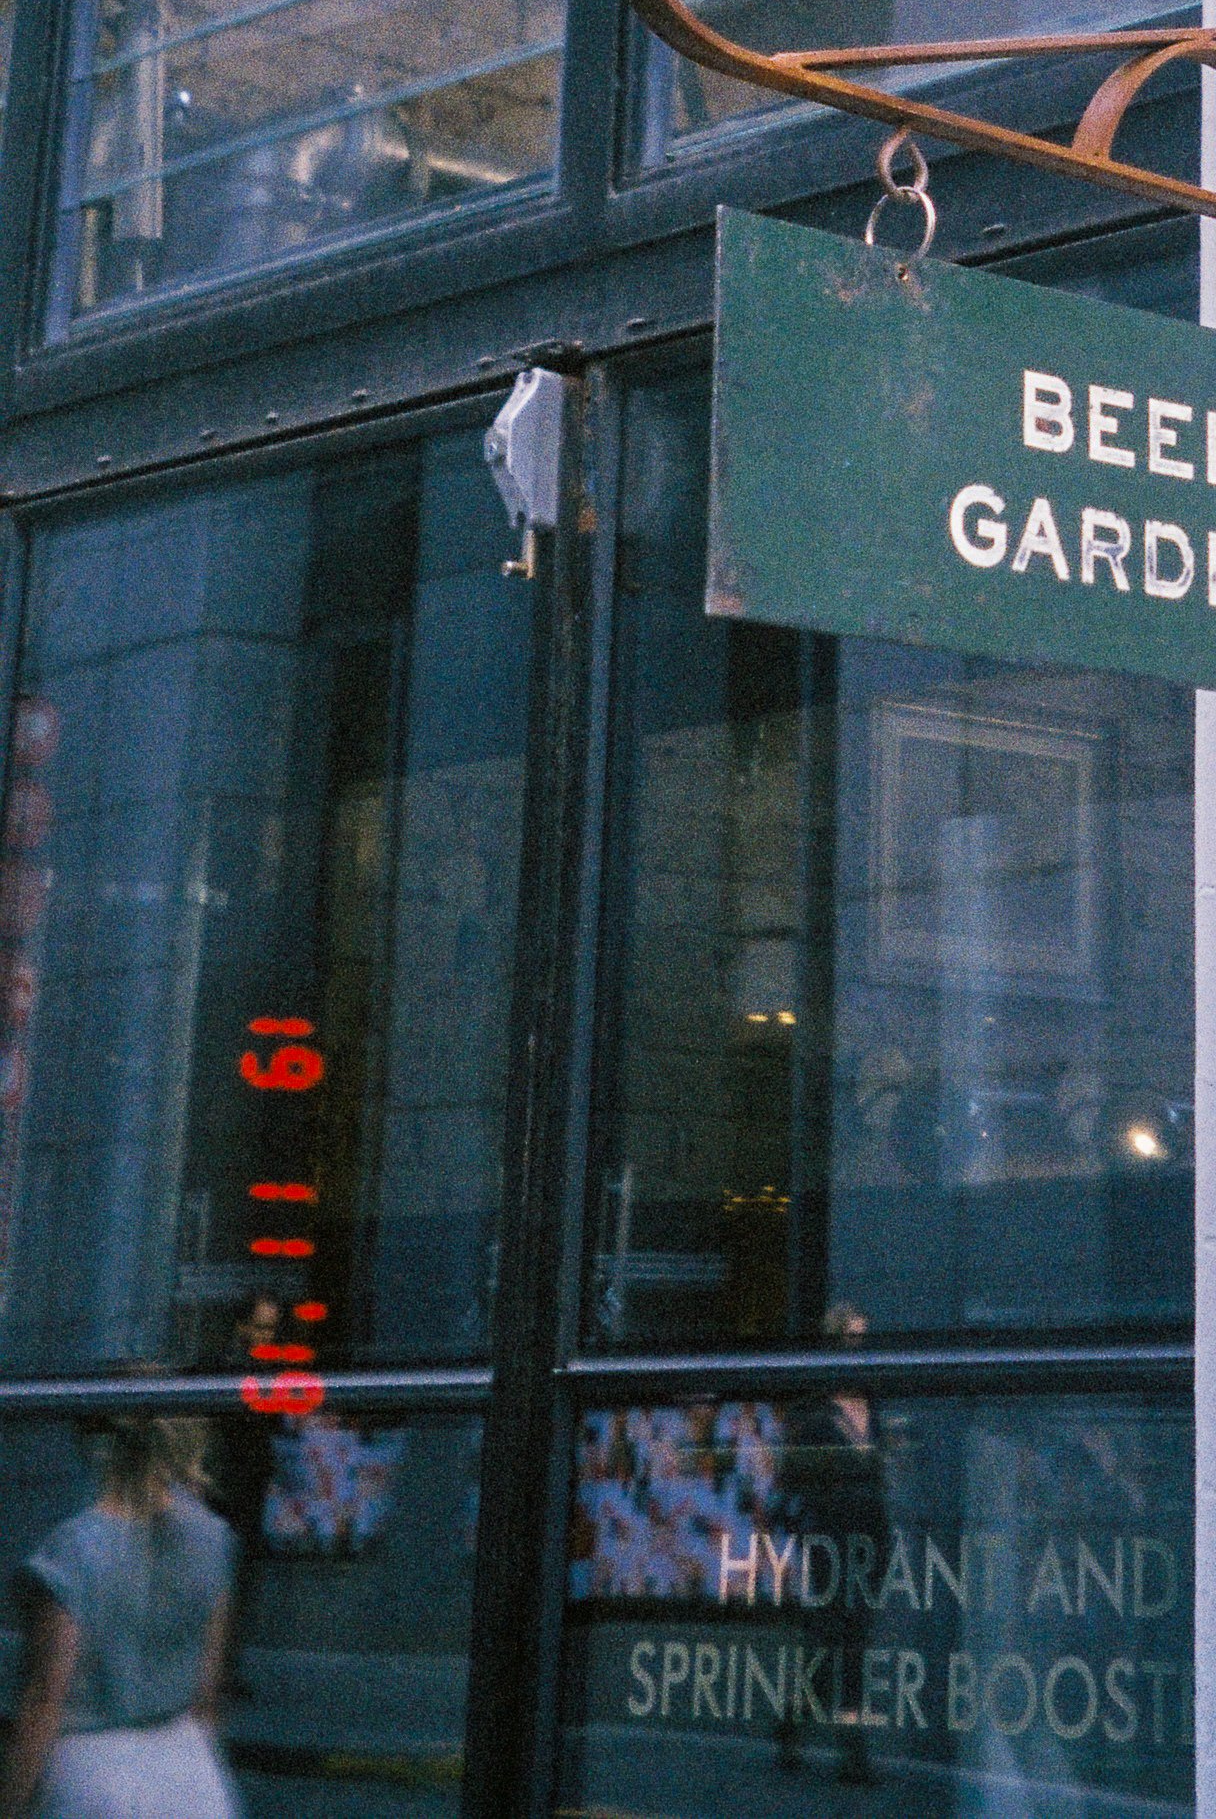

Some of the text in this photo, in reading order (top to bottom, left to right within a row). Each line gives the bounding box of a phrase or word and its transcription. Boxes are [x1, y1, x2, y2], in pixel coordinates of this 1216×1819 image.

[718, 1532, 1178, 1620] HYDRANT AND
[627, 1639, 930, 1731] SPRINKLER
